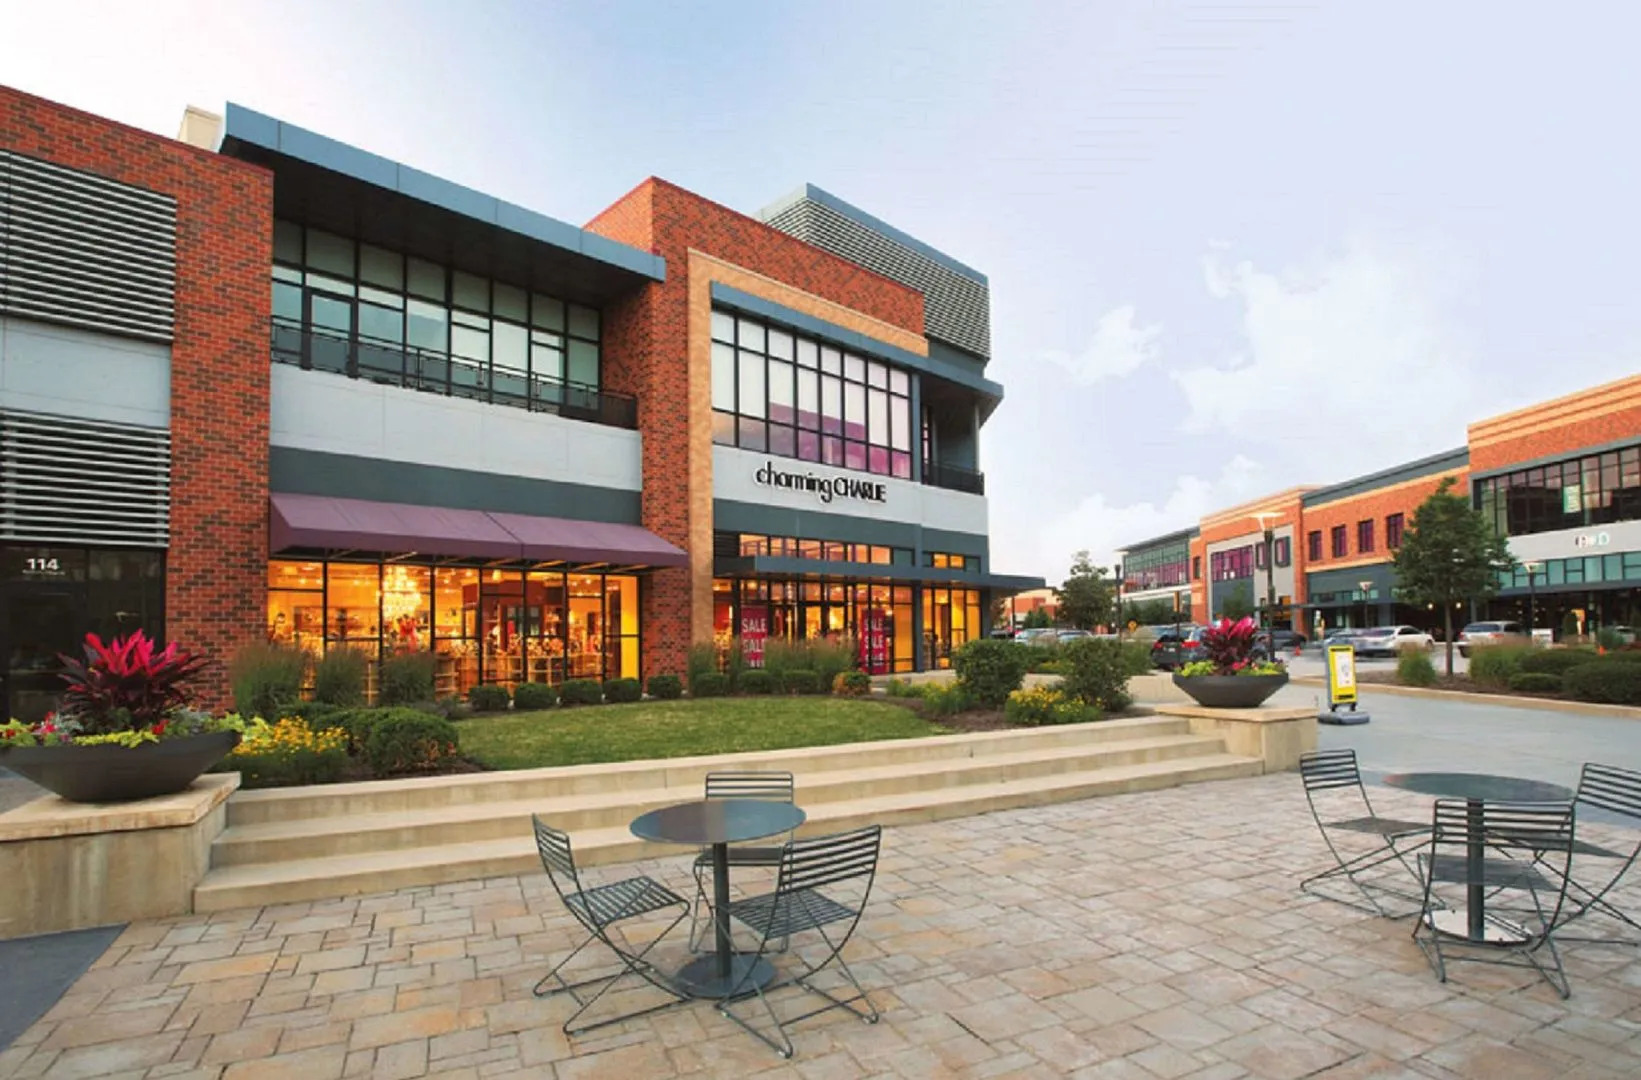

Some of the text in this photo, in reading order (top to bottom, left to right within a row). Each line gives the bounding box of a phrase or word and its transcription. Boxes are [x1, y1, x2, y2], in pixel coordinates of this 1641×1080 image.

[755, 460, 832, 503] charming
[26, 558, 60, 570] 114
[741, 617, 767, 632] SALE
